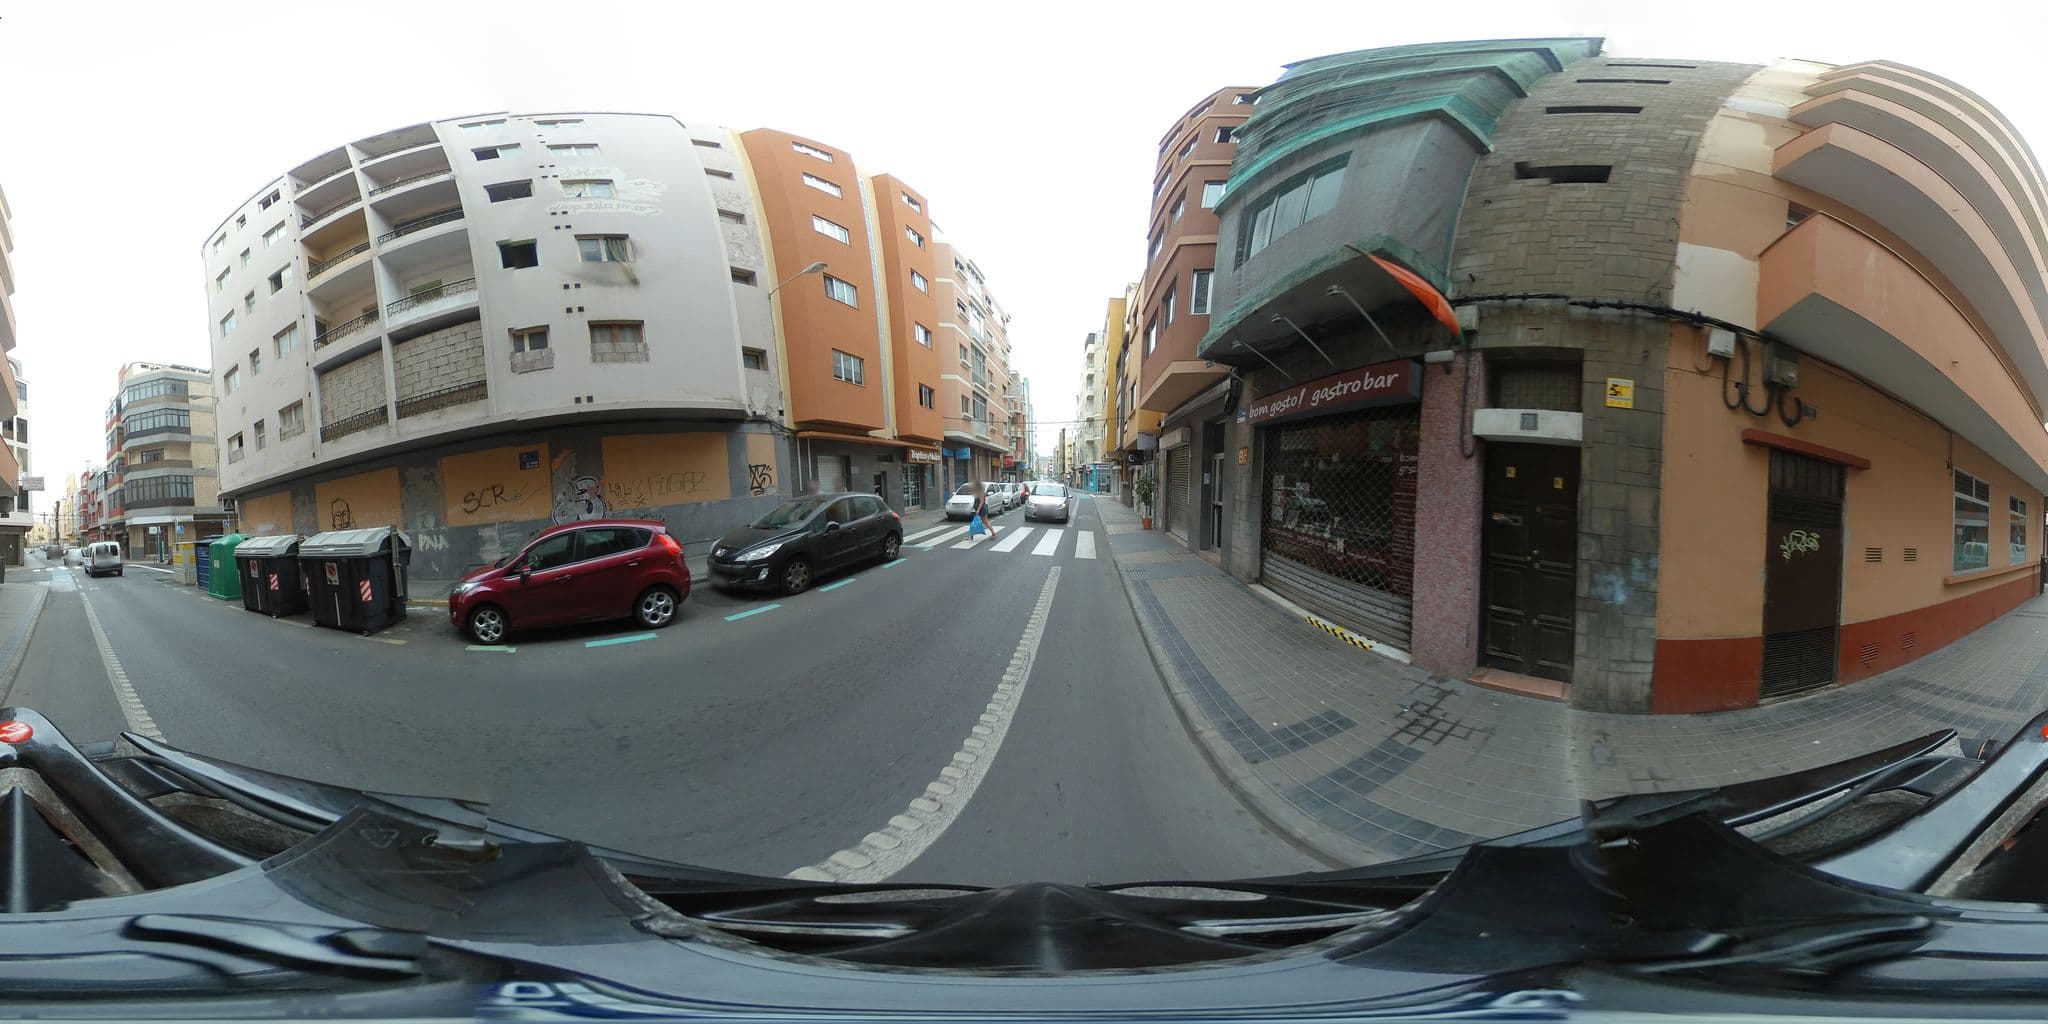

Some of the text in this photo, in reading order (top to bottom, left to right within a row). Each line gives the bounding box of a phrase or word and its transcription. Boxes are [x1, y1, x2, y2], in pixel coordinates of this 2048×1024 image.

[1249, 404, 1269, 418] bom
[1269, 387, 1306, 417] gosto!
[463, 483, 508, 514] SCR
